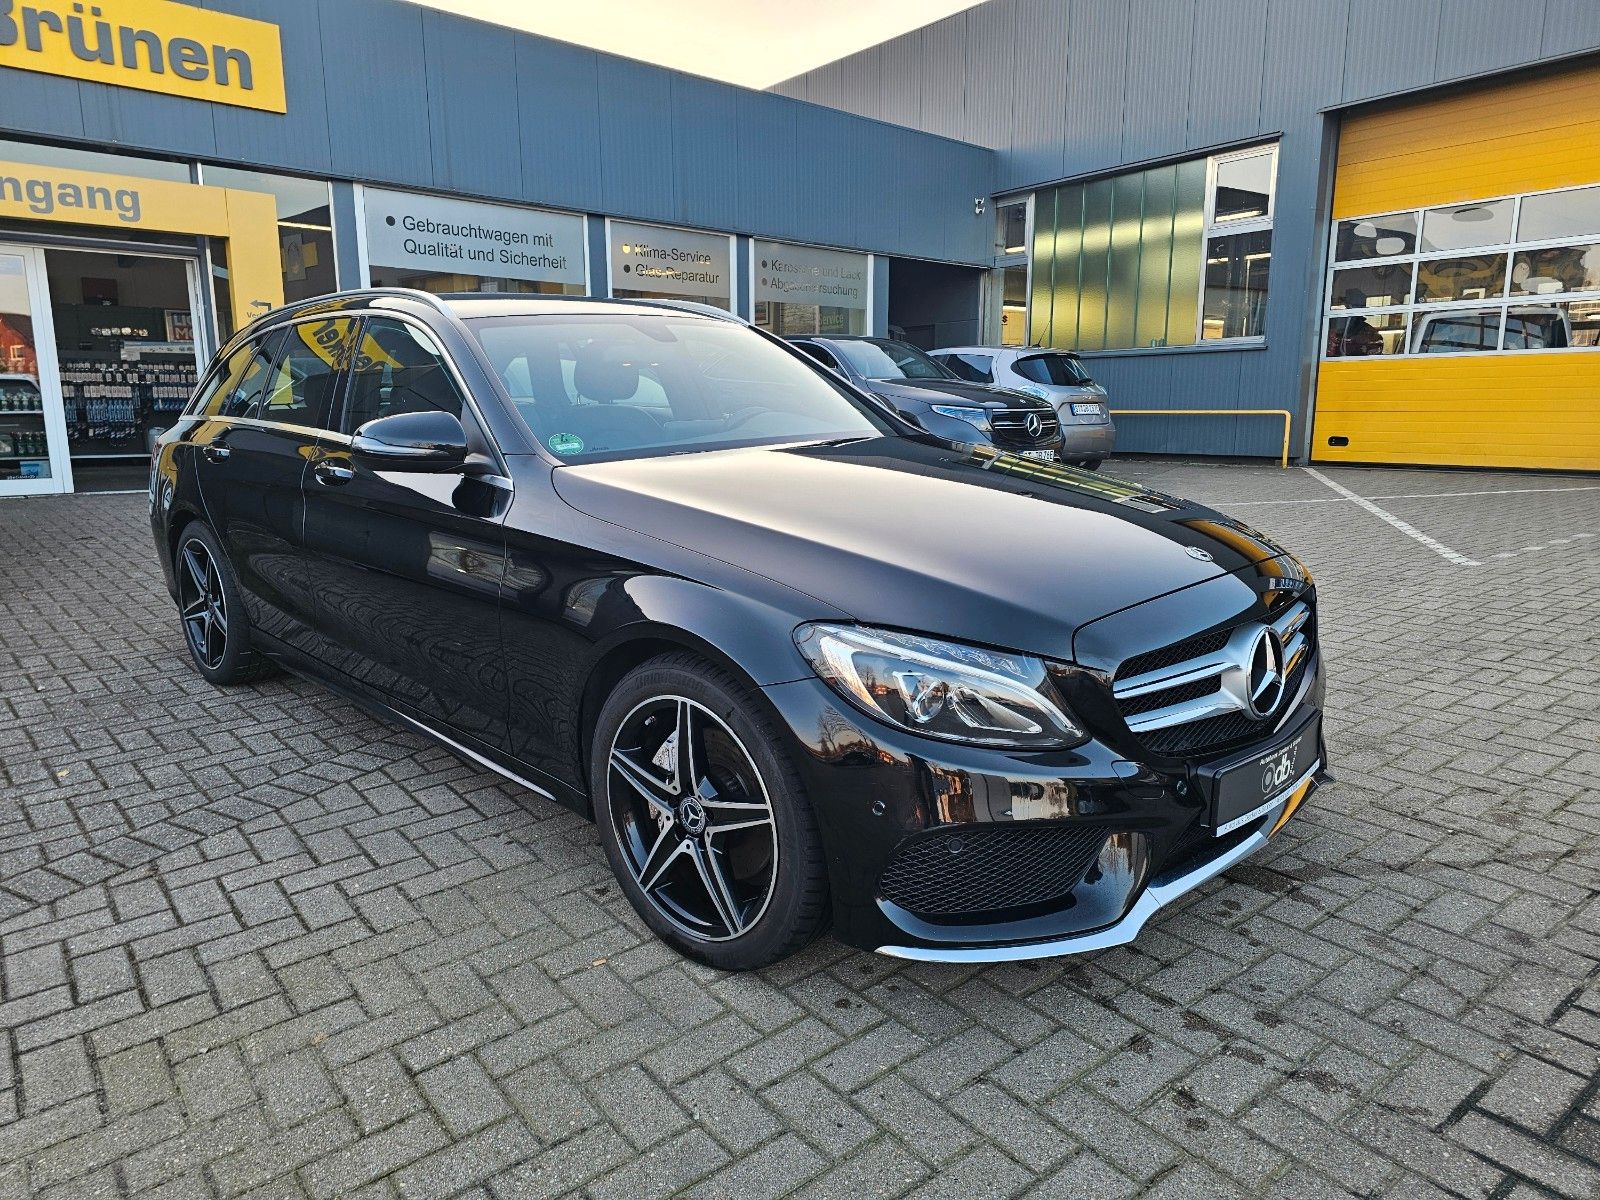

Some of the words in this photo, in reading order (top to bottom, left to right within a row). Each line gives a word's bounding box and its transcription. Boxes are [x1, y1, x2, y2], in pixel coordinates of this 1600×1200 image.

[402, 215, 528, 247] Gebrauchtwagen
[533, 233, 553, 247] mit
[403, 239, 463, 260] Qualität
[468, 247, 495, 262] und
[499, 249, 567, 270] Sicherheit
[634, 243, 711, 265] Klima-Service
[635, 263, 720, 284] Glas-Reparatur
